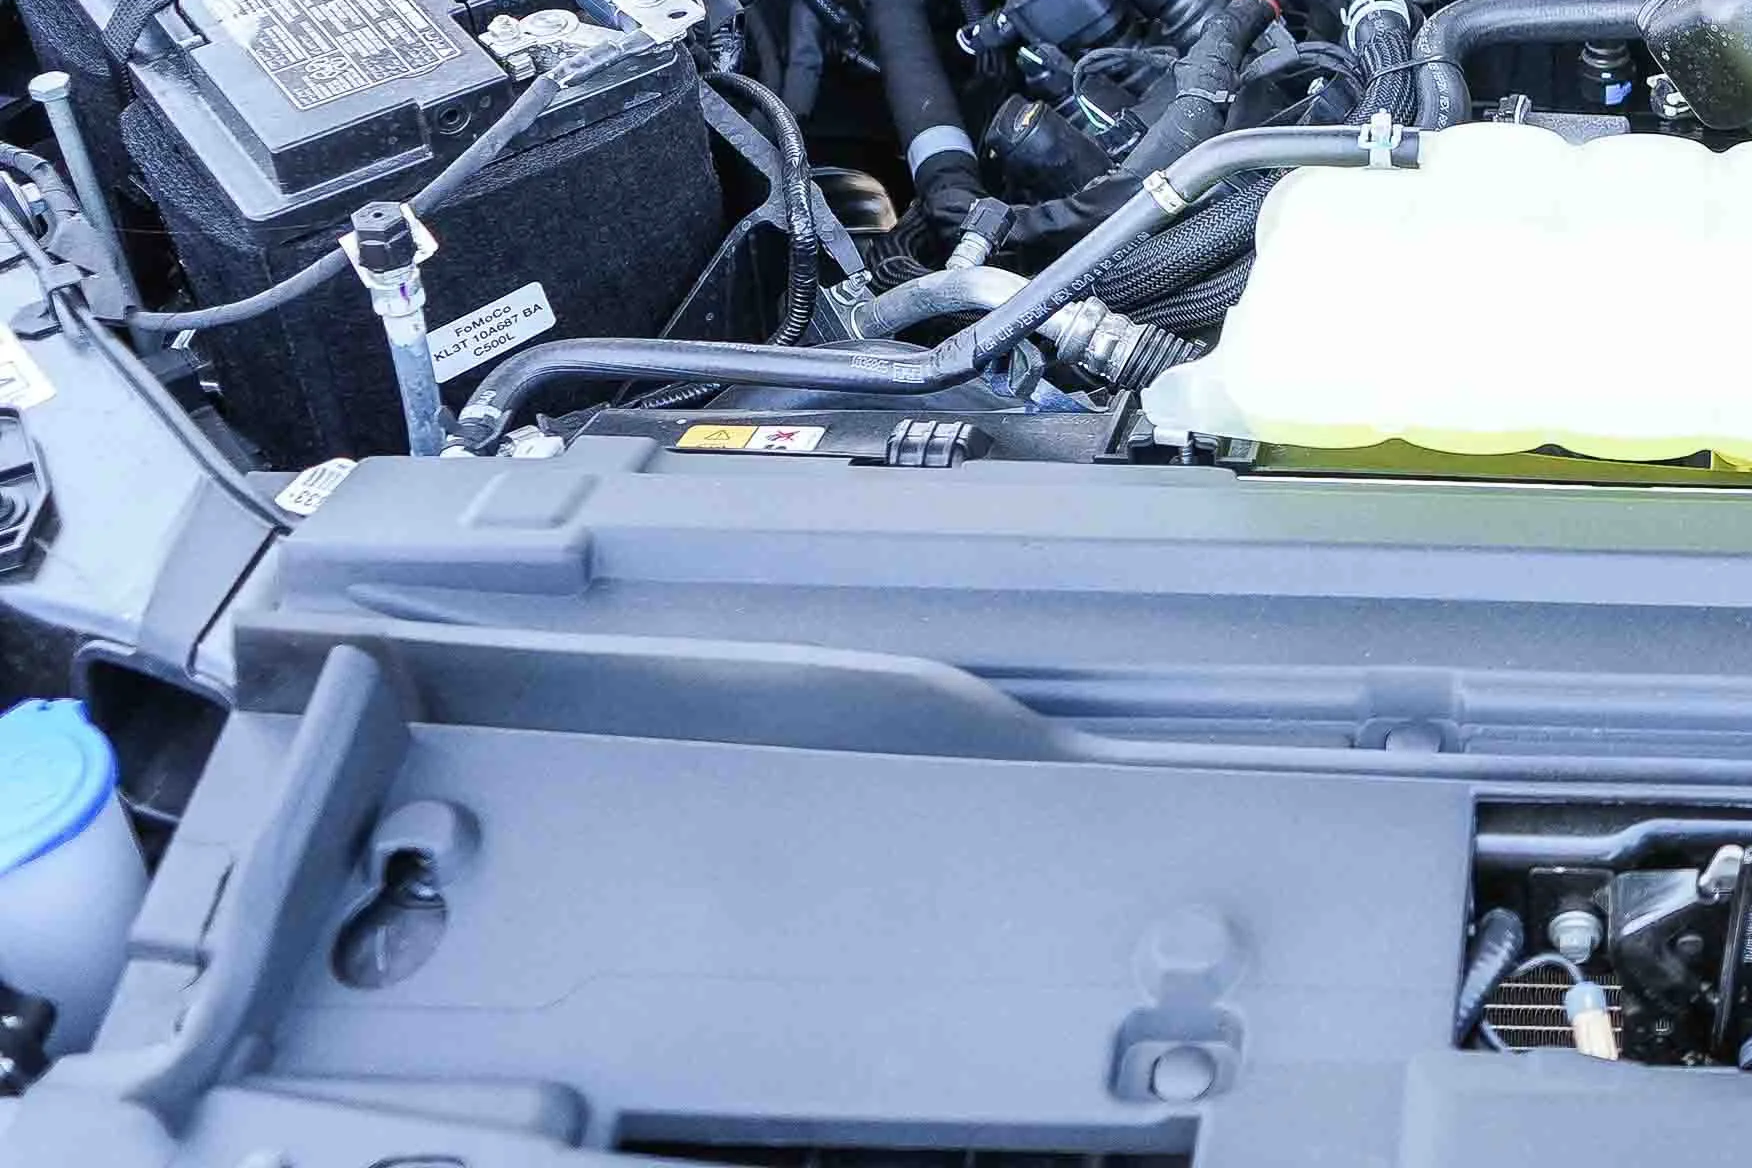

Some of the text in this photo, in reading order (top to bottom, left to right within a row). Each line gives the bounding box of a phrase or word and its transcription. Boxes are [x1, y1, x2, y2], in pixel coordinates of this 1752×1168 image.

[433, 303, 543, 362] KL3T 10A687 BA
[454, 305, 512, 337] FoMoCo
[473, 333, 516, 357] C500L
